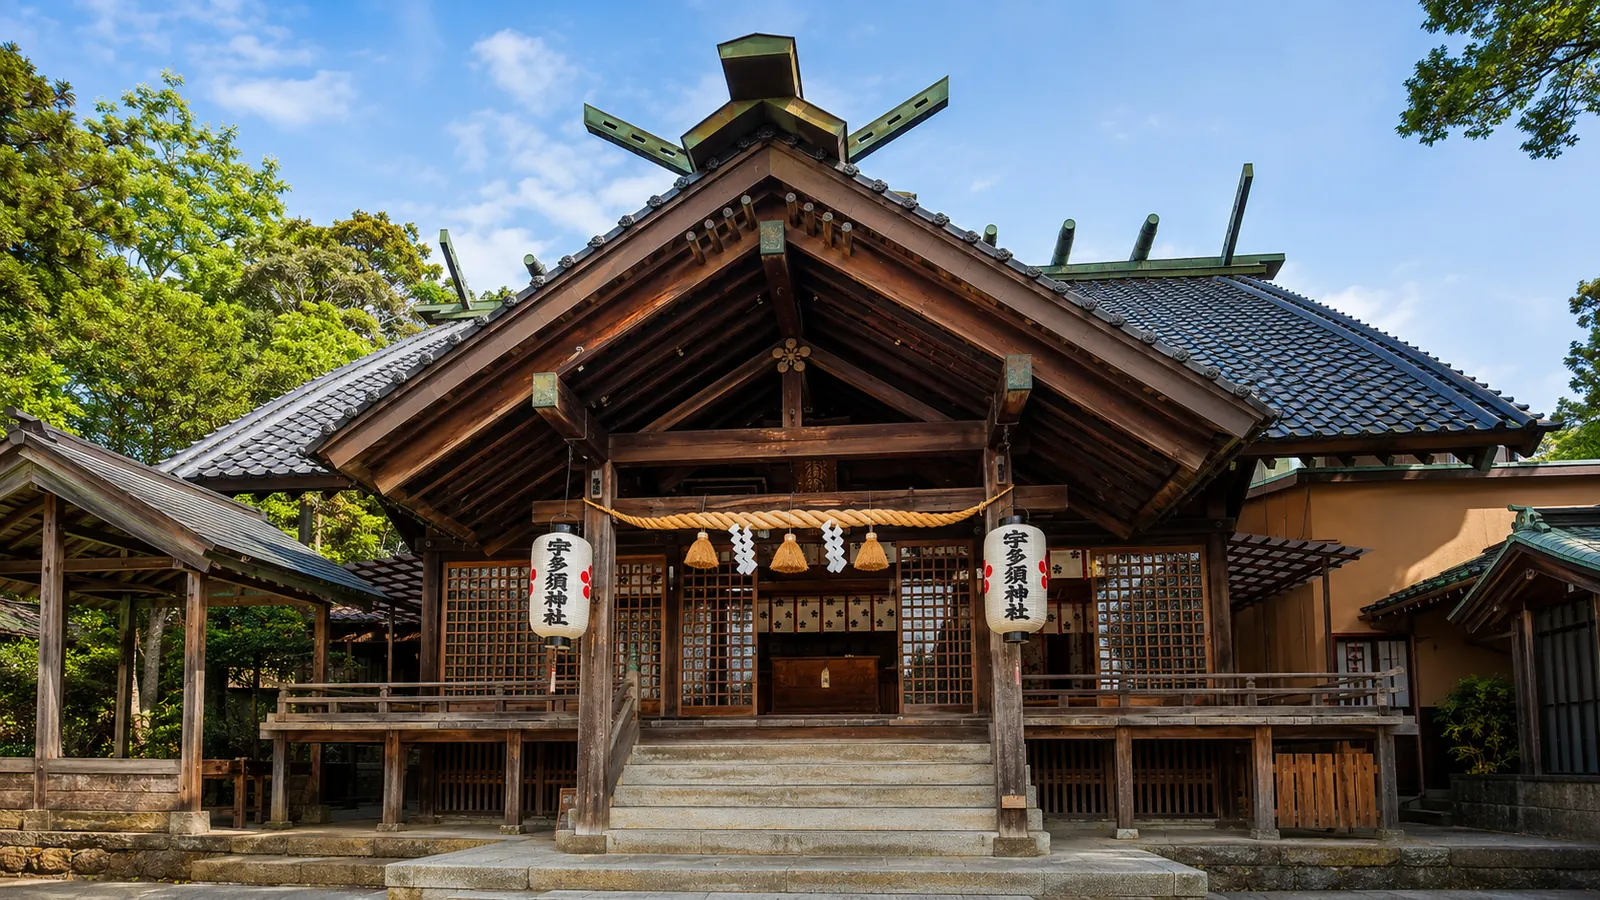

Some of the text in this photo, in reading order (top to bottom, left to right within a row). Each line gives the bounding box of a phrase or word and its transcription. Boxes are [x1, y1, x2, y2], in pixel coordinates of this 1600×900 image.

[542, 537, 572, 626] 宇多須神社
[1003, 529, 1031, 621] 宇多須神社
